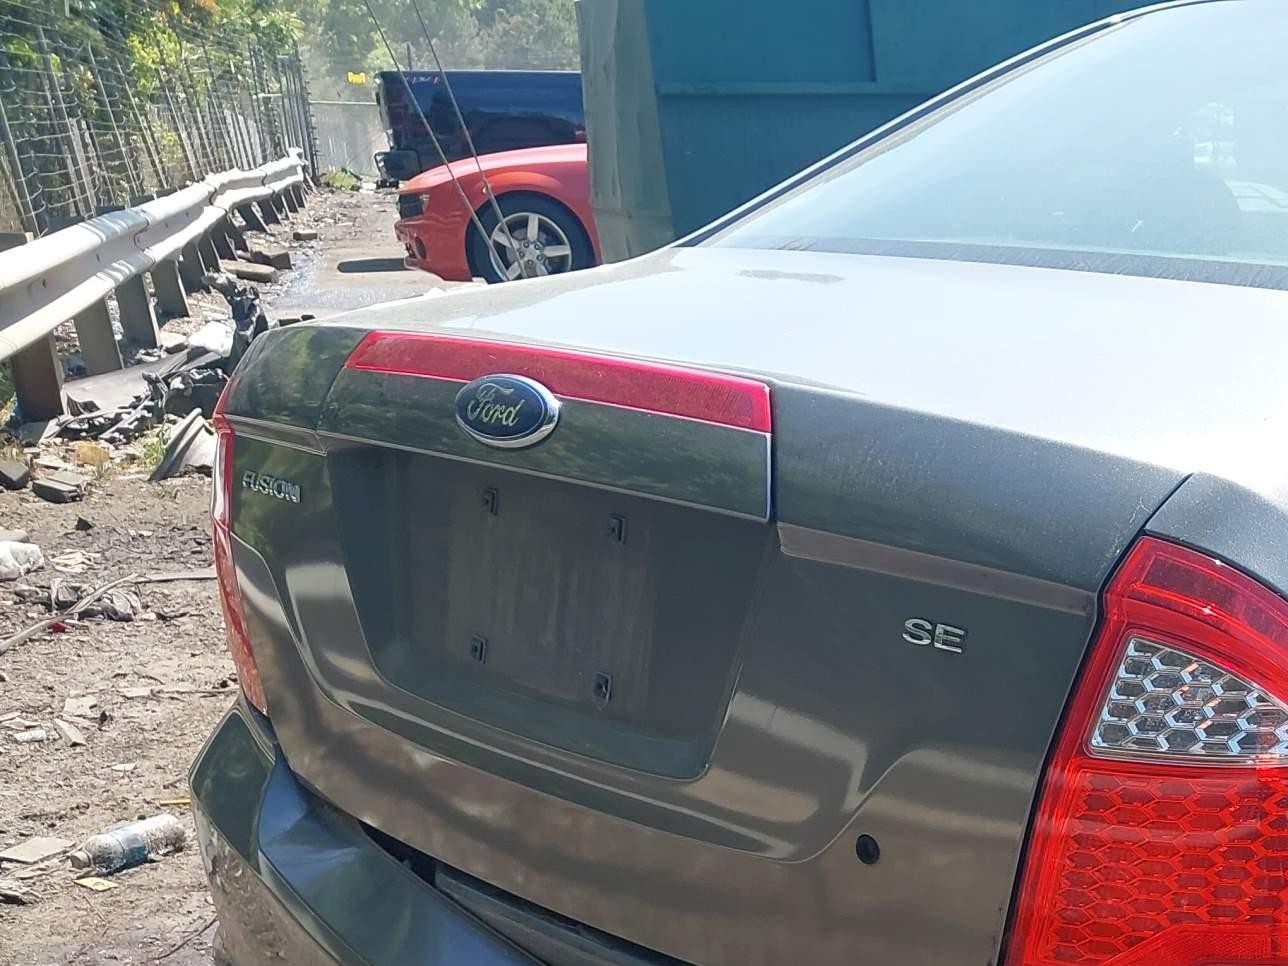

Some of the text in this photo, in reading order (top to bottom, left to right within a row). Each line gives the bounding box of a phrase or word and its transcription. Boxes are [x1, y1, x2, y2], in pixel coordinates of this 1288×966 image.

[467, 382, 526, 427] Ford
[242, 470, 301, 503] FUSION
[902, 618, 965, 653] SE
